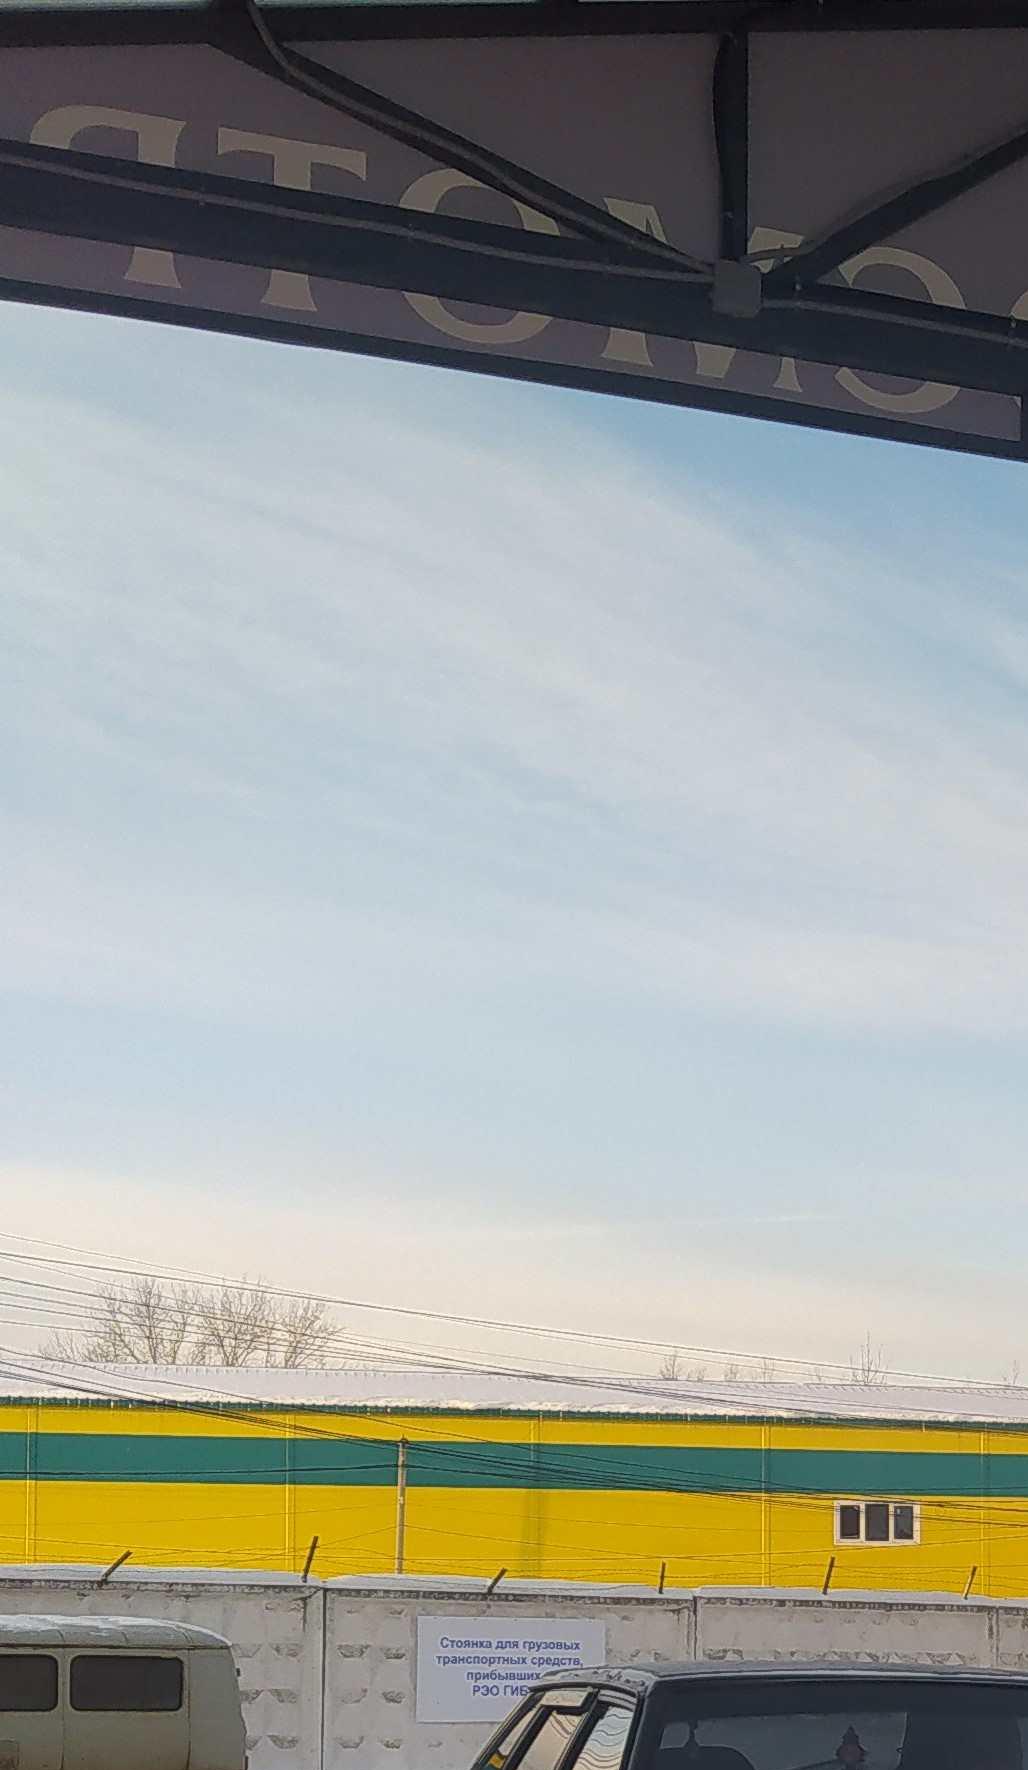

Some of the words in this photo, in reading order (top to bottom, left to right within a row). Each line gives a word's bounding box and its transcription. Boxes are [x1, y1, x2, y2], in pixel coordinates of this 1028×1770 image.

[440, 1637, 492, 1650] Стоянка
[495, 1641, 519, 1650] для
[523, 1641, 581, 1653] грузовых
[436, 1655, 527, 1667] транспортных
[531, 1656, 584, 1668] средств,
[467, 1670, 541, 1682] прибывших
[473, 1685, 500, 1697] РЭО
